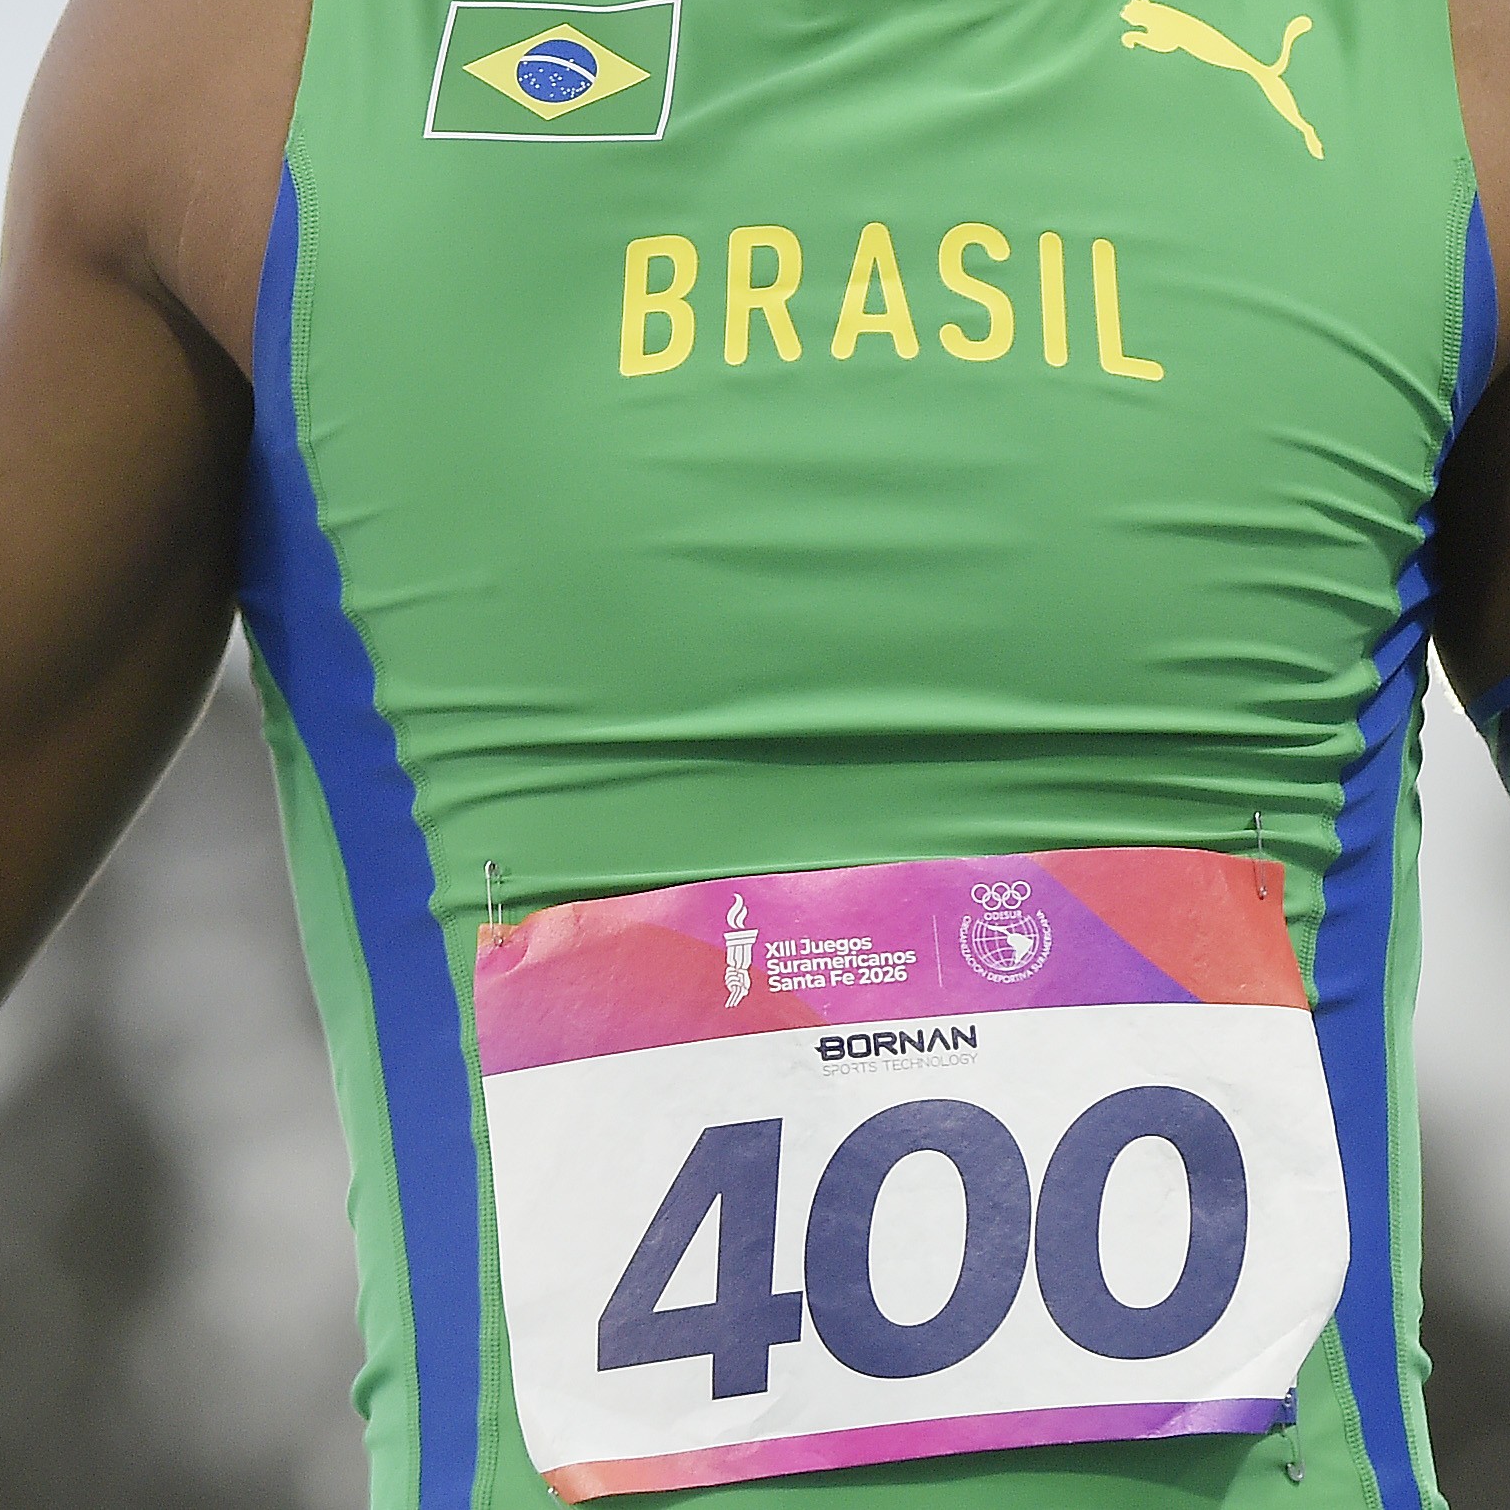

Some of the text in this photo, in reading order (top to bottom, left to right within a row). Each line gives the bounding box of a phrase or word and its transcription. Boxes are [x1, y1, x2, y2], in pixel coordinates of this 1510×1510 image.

[619, 222, 1164, 381] BRASIL
[984, 910, 1022, 922] ODESUR
[765, 937, 872, 958] XIII Juegos
[767, 950, 916, 975] Suramericanos
[768, 965, 907, 992] Santa Fe 2026
[986, 969, 1034, 984] DEPORTIVA
[815, 1024, 977, 1061] BORNAN
[822, 1052, 978, 1077] SPORTS TECHNOLOGY
[596, 1084, 1249, 1402] 400
